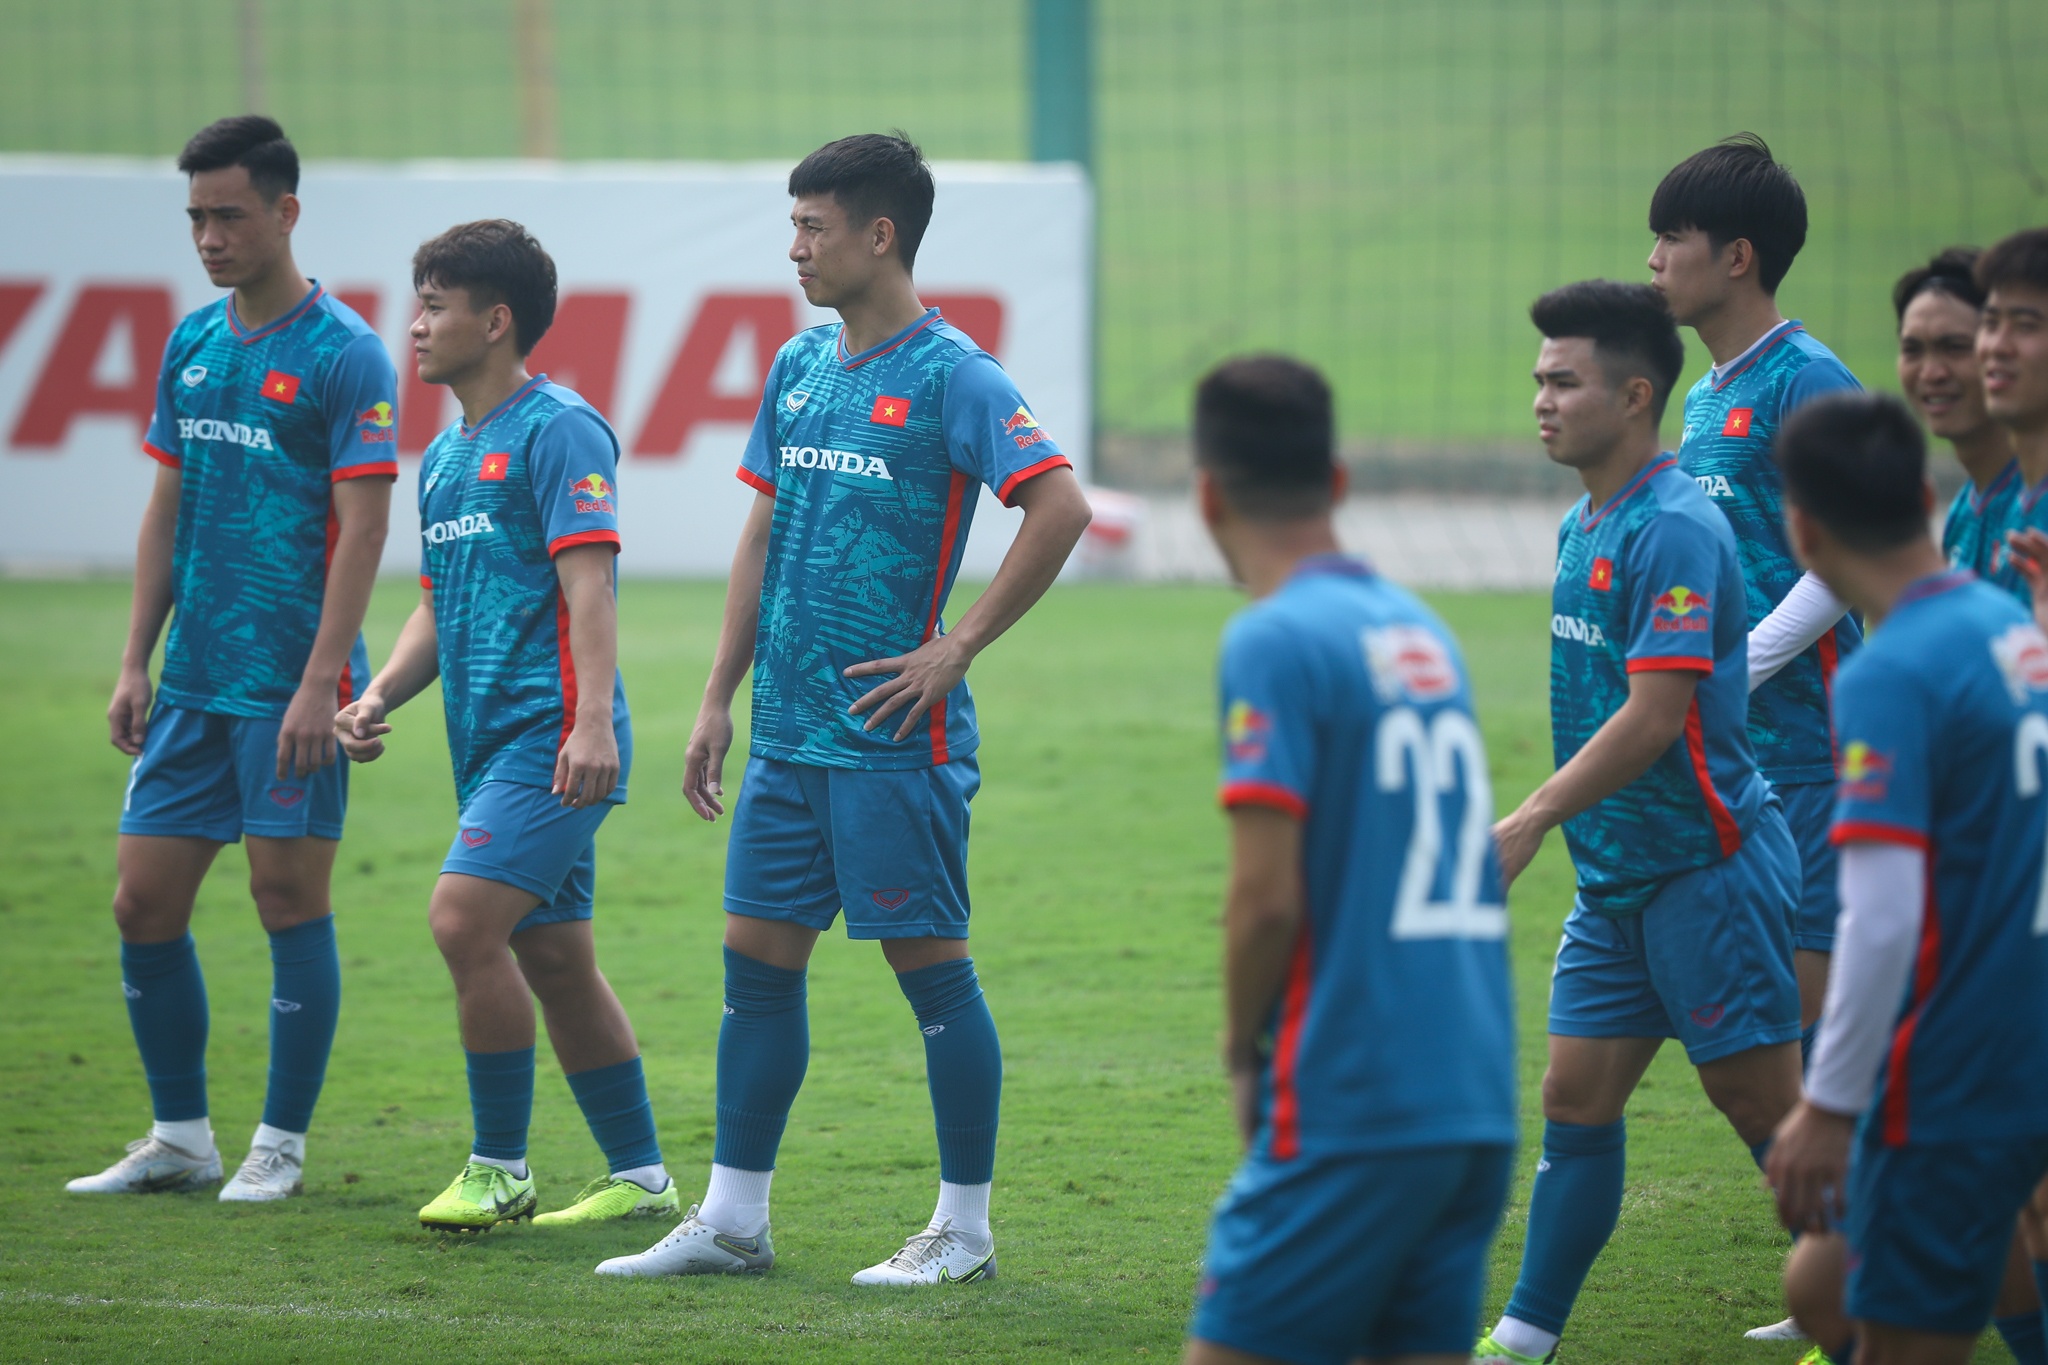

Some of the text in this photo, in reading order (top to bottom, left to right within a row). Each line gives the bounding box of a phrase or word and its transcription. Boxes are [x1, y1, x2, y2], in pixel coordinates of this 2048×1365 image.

[0, 278, 1007, 455] AMA
[177, 418, 274, 451] HONDA
[361, 429, 385, 444] Red
[1014, 428, 1042, 449] Red
[779, 446, 894, 480] HONDA
[575, 498, 600, 513] Red
[1552, 614, 1606, 647] ONA
[1374, 707, 1507, 940] 22
